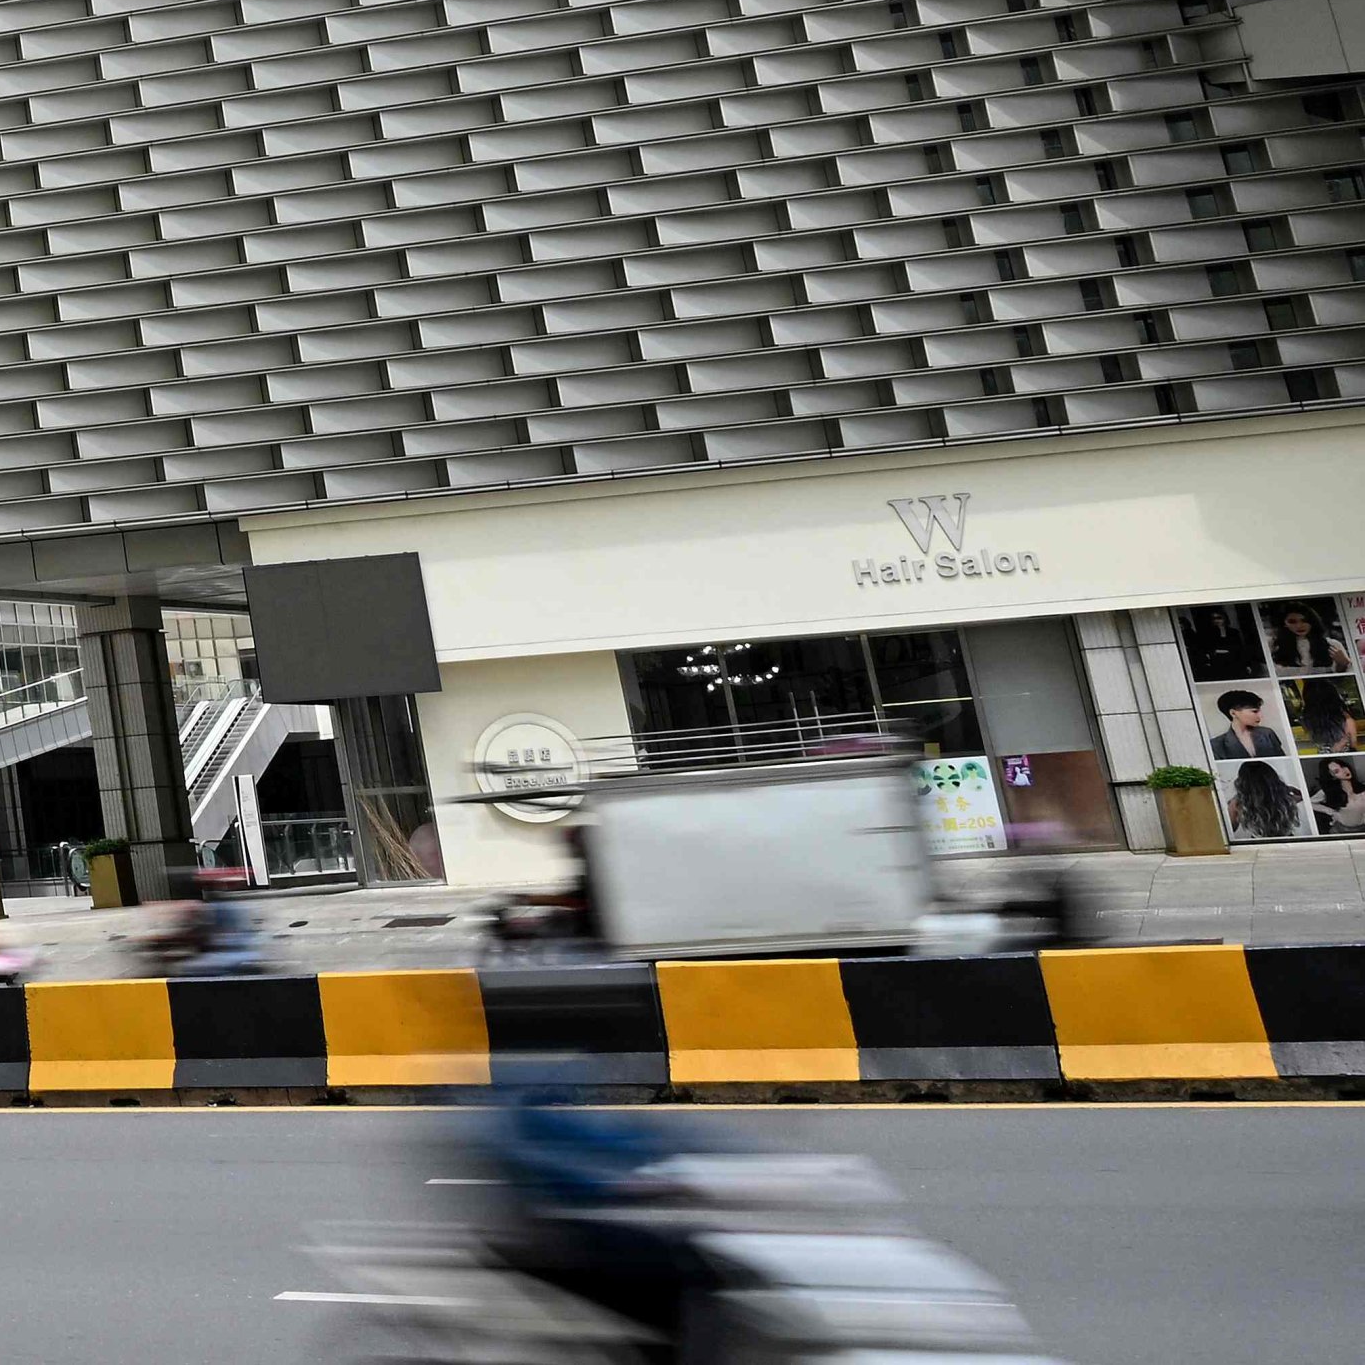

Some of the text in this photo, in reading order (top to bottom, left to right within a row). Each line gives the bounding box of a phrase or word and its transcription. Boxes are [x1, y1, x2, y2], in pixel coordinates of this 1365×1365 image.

[886, 492, 971, 554] W
[852, 549, 1041, 586] Hair Salon
